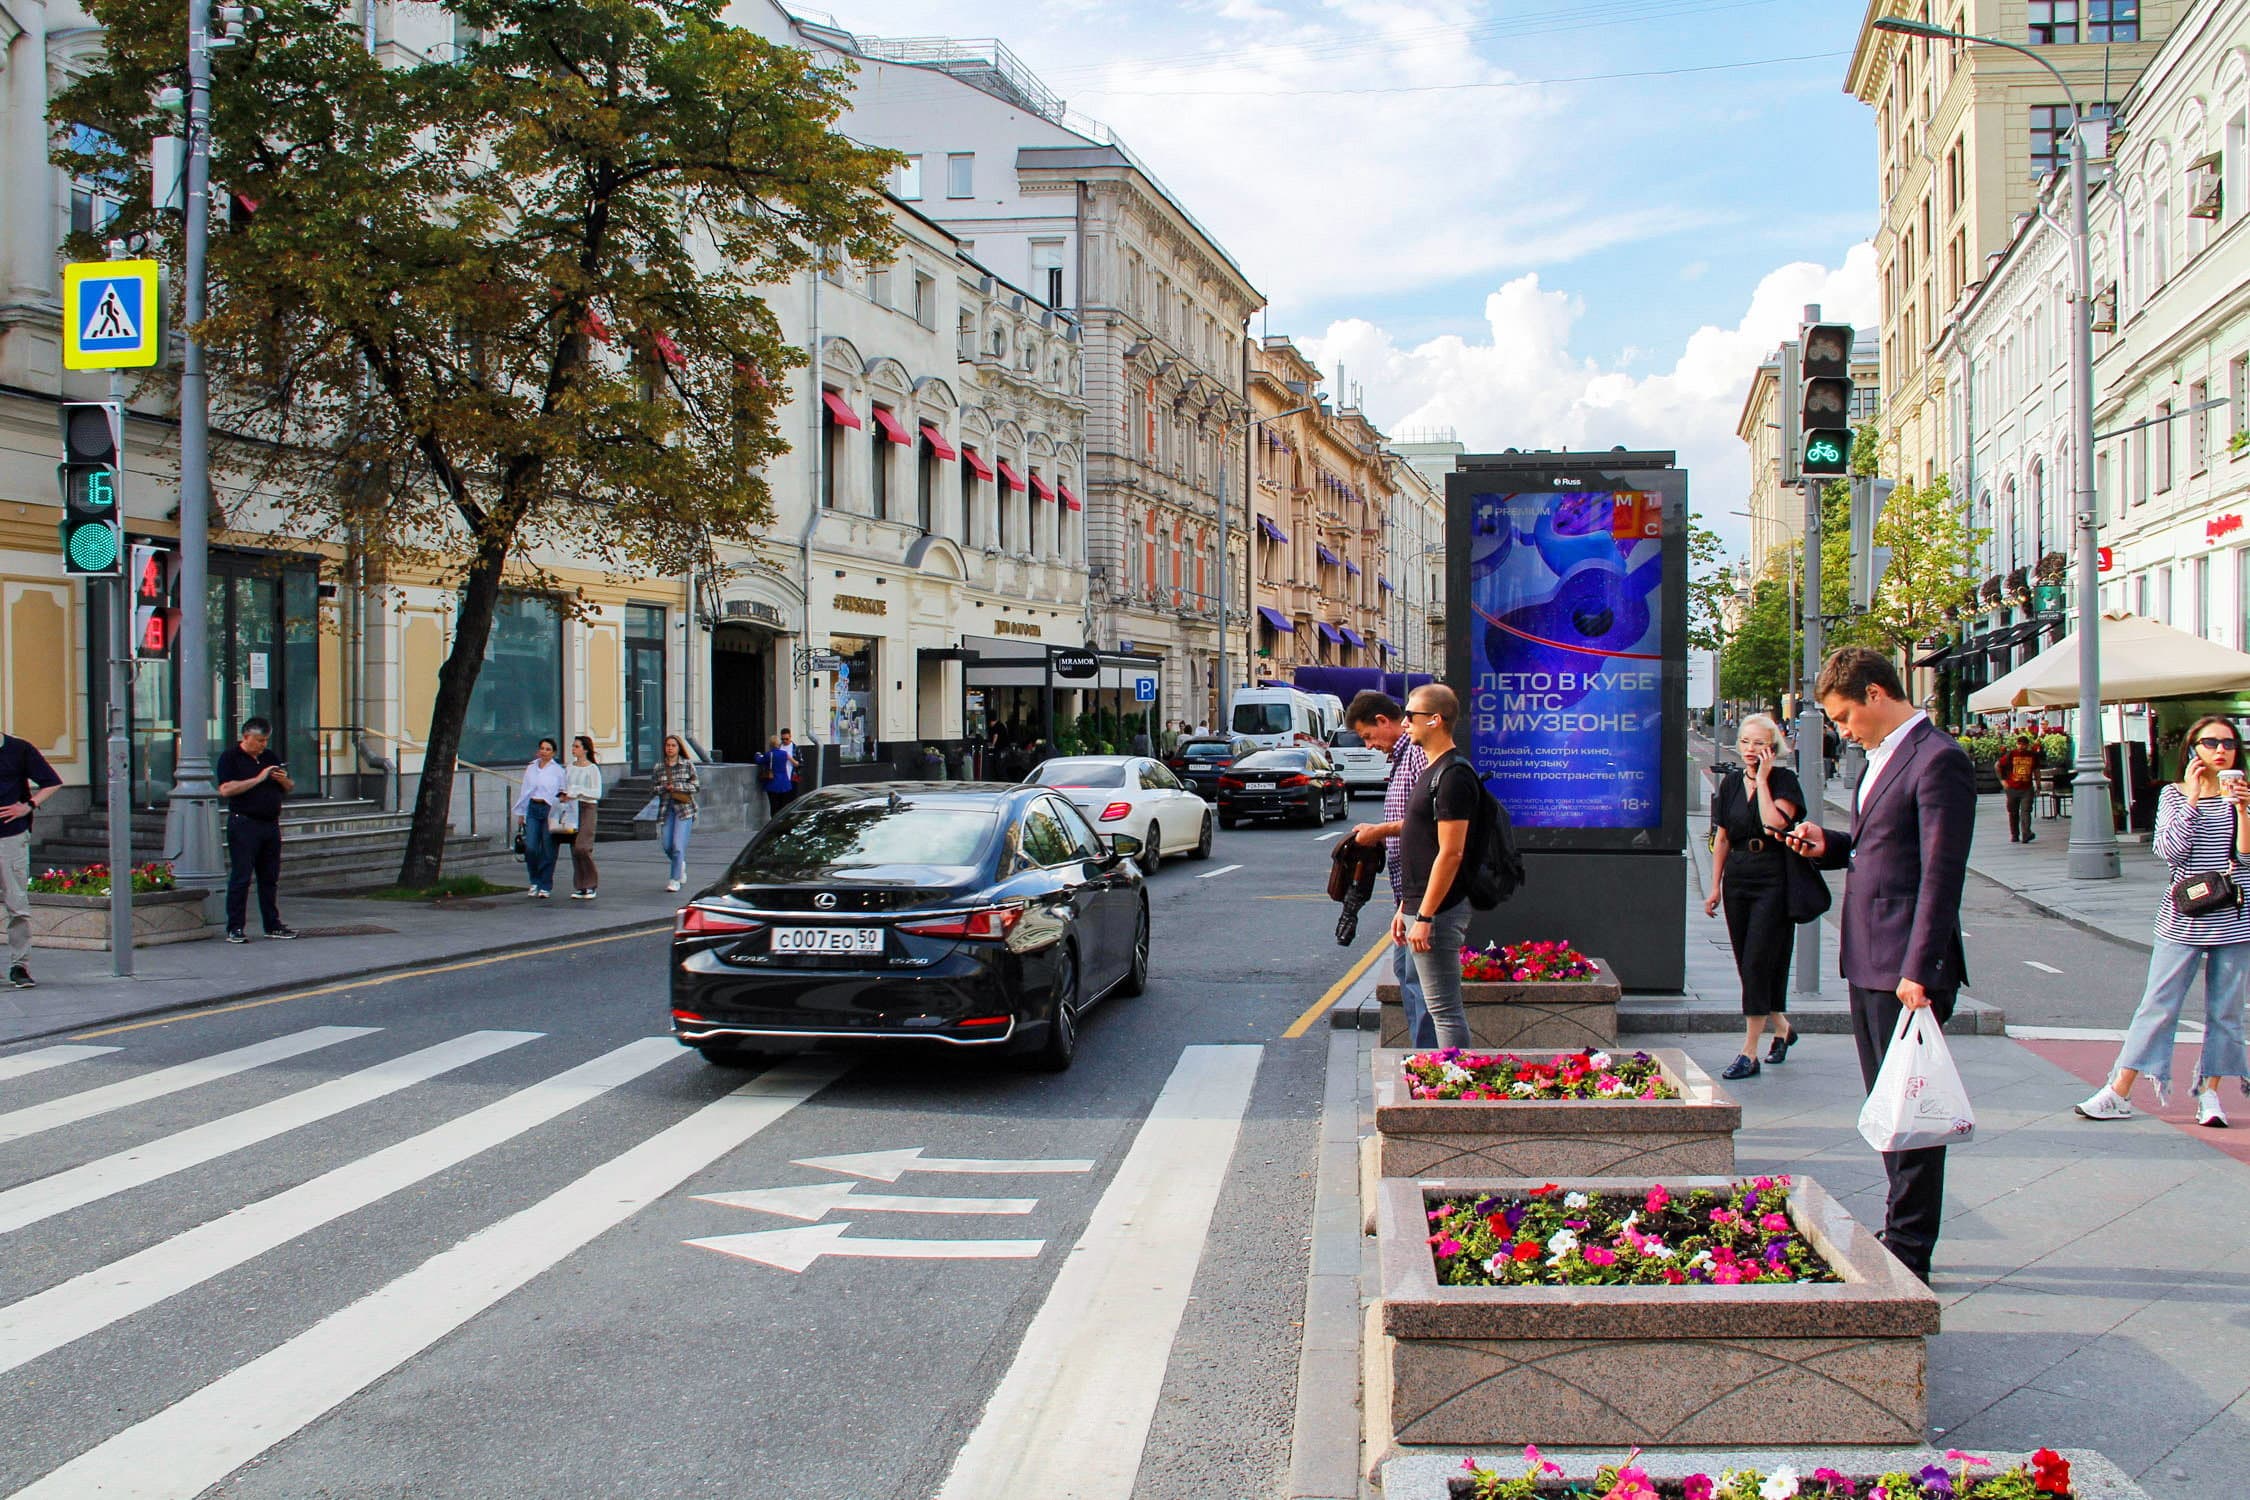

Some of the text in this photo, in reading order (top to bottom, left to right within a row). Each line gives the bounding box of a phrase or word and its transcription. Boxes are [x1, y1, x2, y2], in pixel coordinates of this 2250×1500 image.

[88, 471, 113, 504] 16
[1494, 507, 1551, 516] PREMIUM
[1478, 673, 1655, 691] ЛЕТО В КУБЕ
[1141, 680, 1151, 698] P
[1478, 693, 1563, 711] С МТС
[1478, 714, 1639, 732] В МУЗЕОНЕ
[1479, 746, 1612, 756] Отдыхай, смотри кино,
[1479, 758, 1569, 768] слушай музыку
[1533, 771, 1616, 781] пространстве
[1618, 771, 1644, 779] МТС
[1621, 798, 1650, 810] 18+
[858, 930, 877, 943] 50
